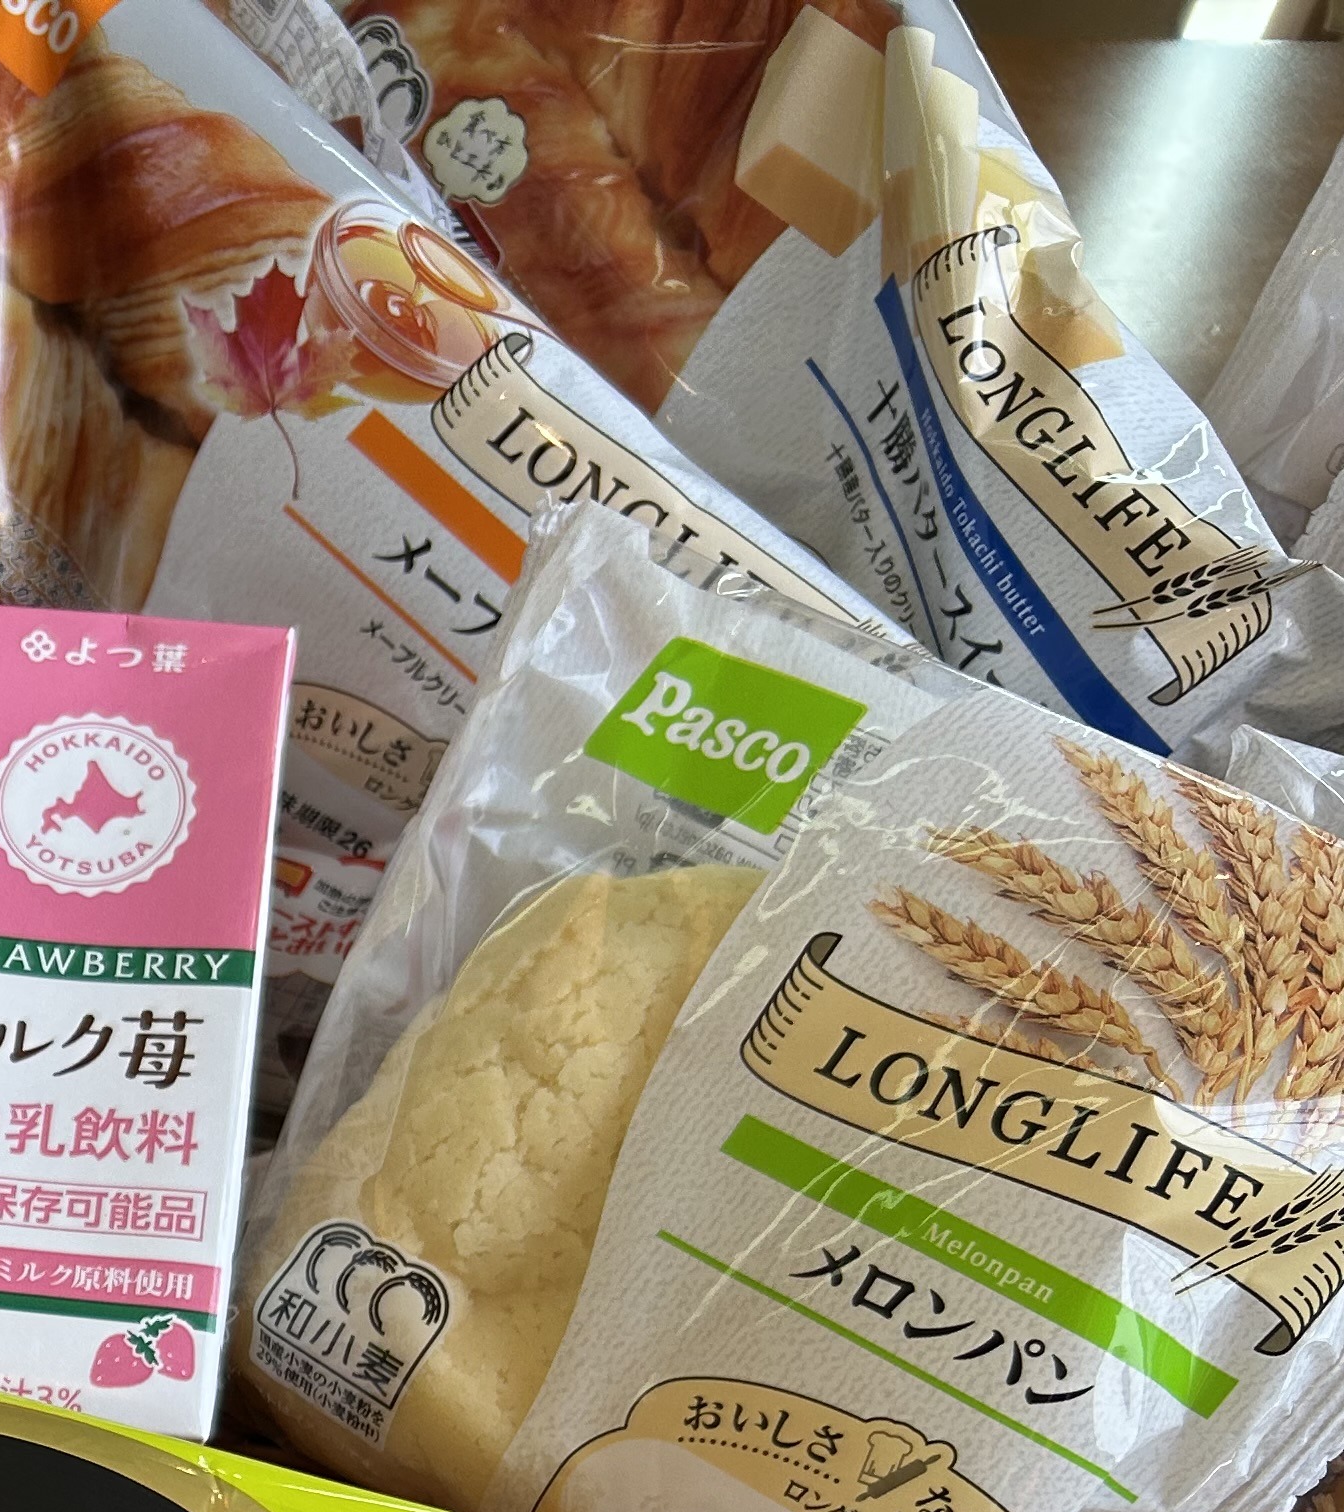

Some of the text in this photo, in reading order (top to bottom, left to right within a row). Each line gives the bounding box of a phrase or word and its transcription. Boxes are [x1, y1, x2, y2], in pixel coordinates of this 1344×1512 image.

[939, 298, 1192, 579] LONGLIFE
[866, 379, 1008, 688] 十勝バタースイ
[952, 495, 1007, 577] Tokachi
[996, 565, 1048, 638] butter
[64, 636, 189, 674] よつ葉
[24, 731, 165, 782] HOKKAIDO
[295, 700, 412, 767] おいしさ
[621, 671, 811, 783] Pasco
[24, 833, 154, 876] YOTSUBA
[4, 1103, 199, 1167] 乳飲料
[812, 1024, 1264, 1232] LONGLIFE
[919, 1220, 1055, 1304] Melonpan
[268, 1288, 405, 1398] 和小麦
[788, 1245, 1096, 1405] メロンパン
[254, 1328, 386, 1428] 国産小麦の小麦粉を
[682, 1395, 846, 1466] おいしさ
